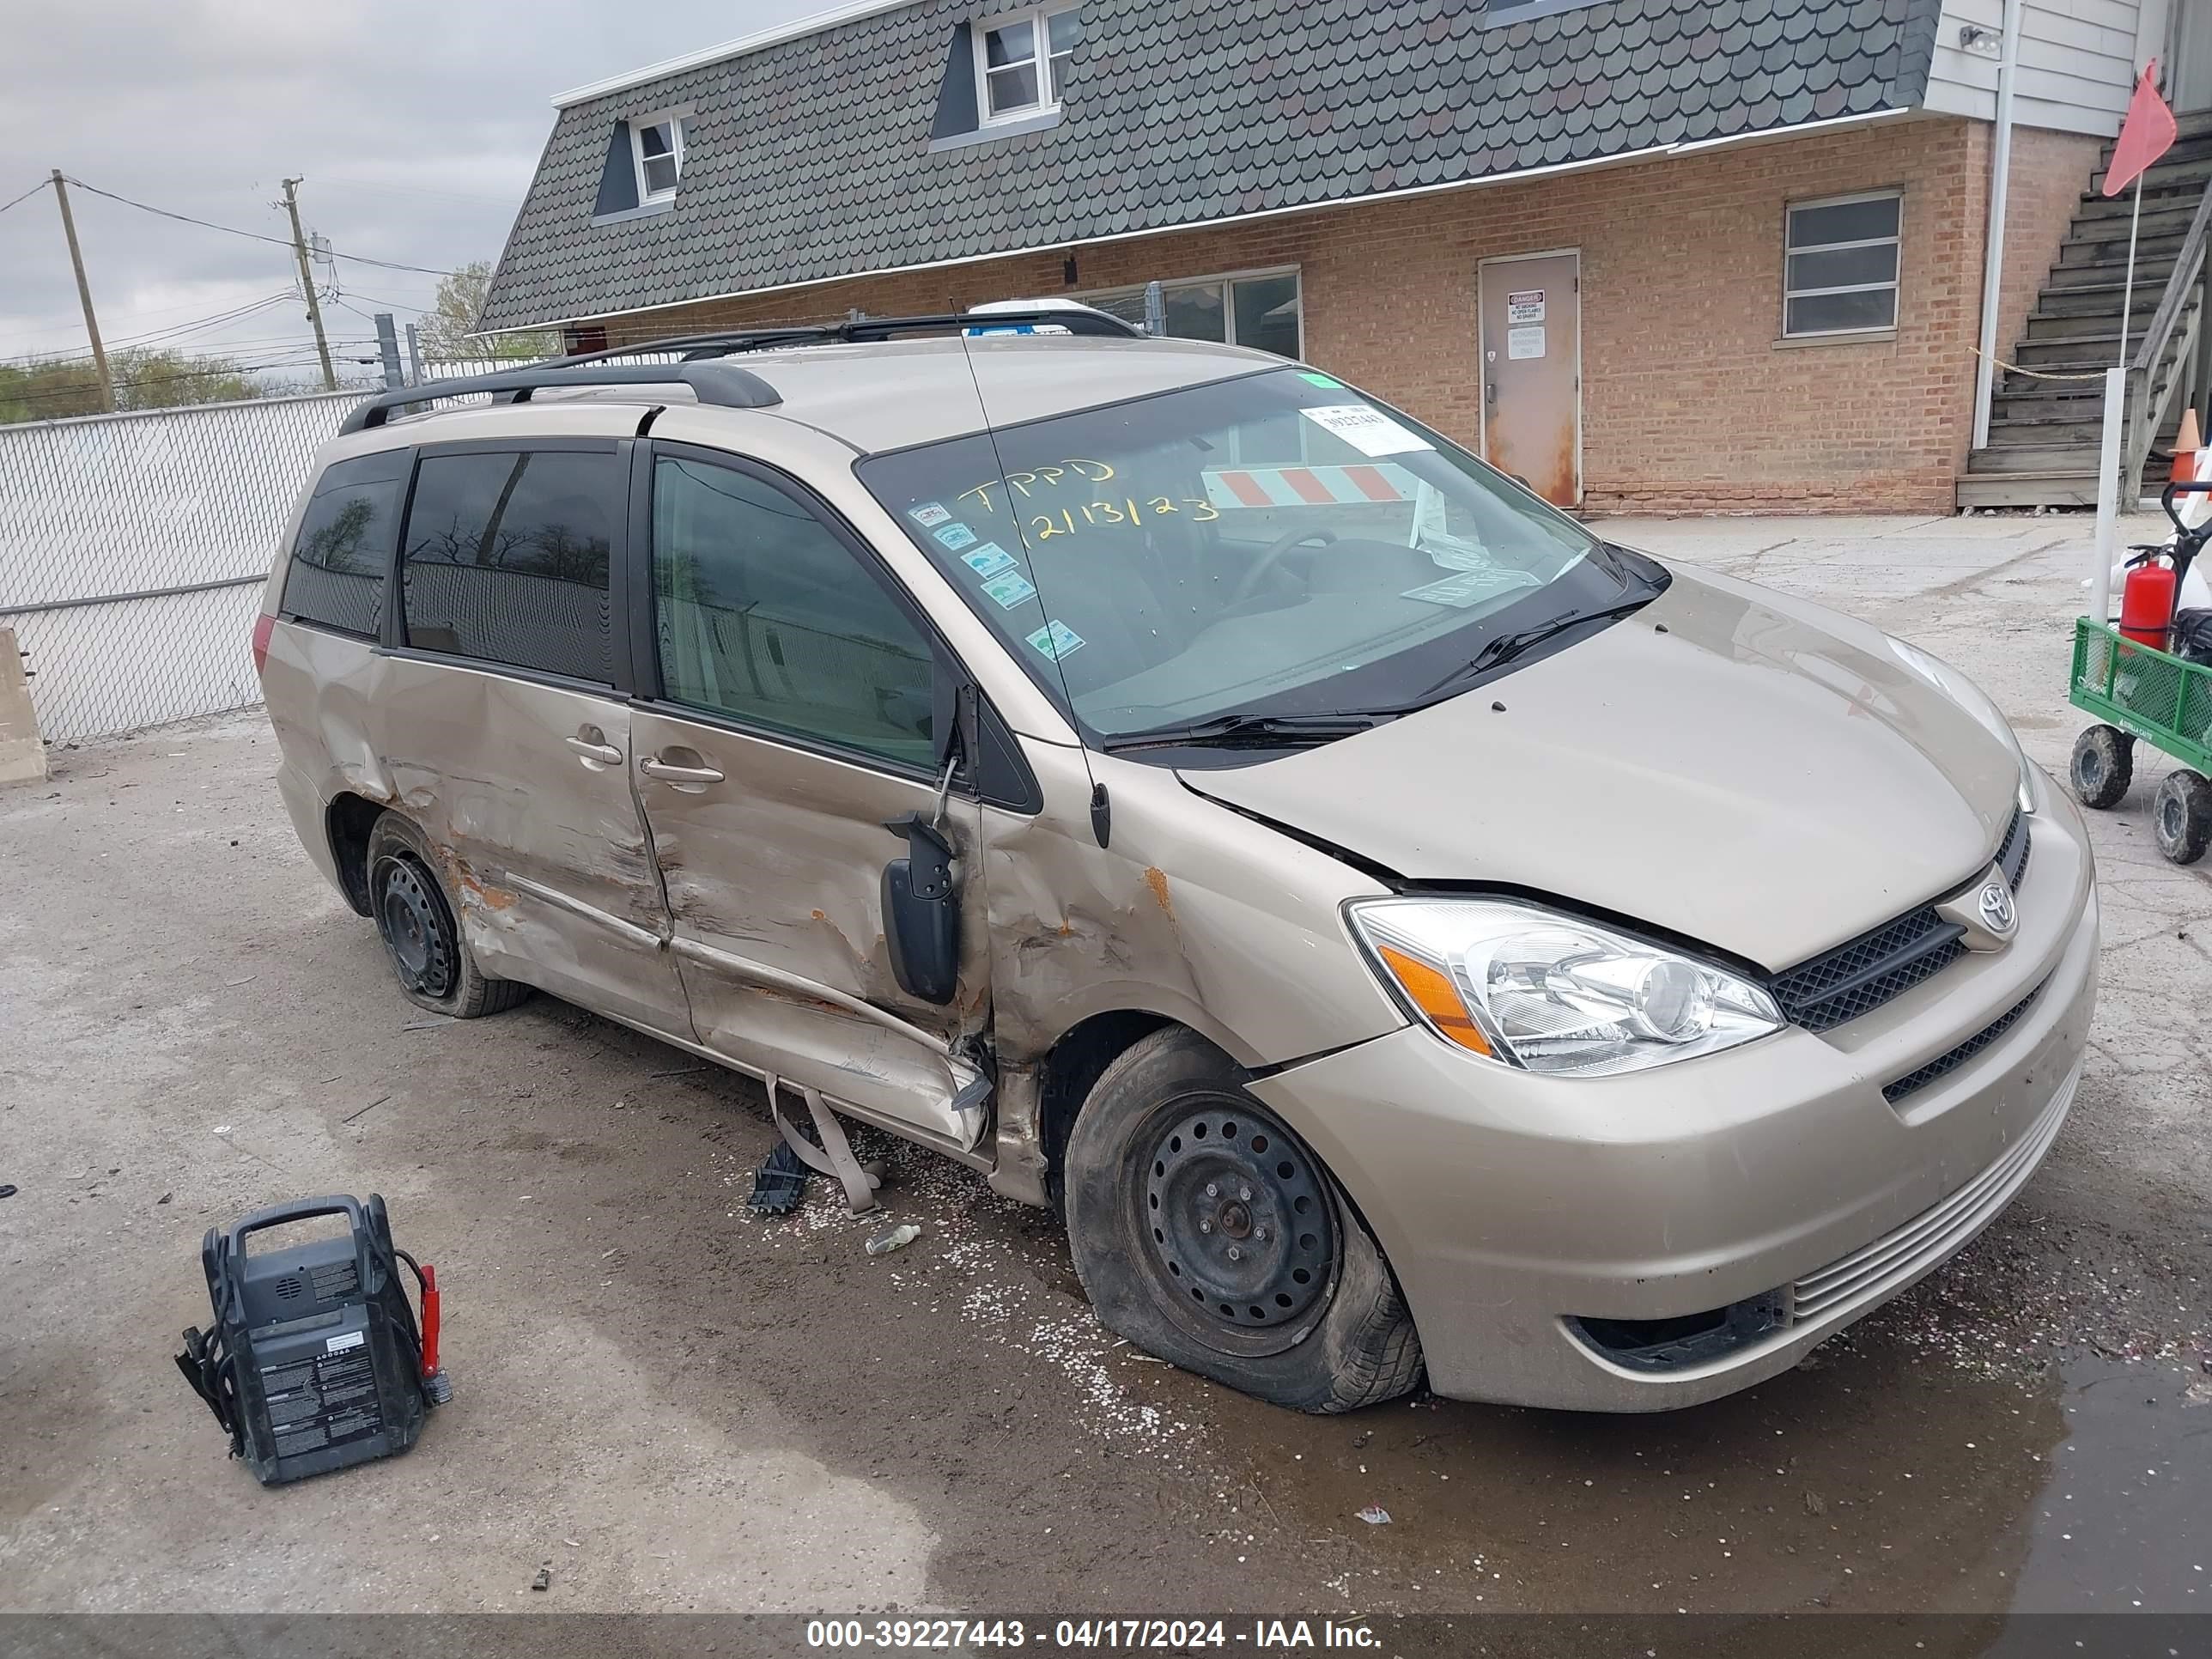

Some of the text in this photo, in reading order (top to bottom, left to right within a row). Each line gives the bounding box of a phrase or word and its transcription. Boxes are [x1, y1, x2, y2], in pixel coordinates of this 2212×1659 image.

[1514, 295, 1539, 303] DANGER
[1323, 414, 1385, 428] 39227443
[957, 459, 1115, 514] TPPD
